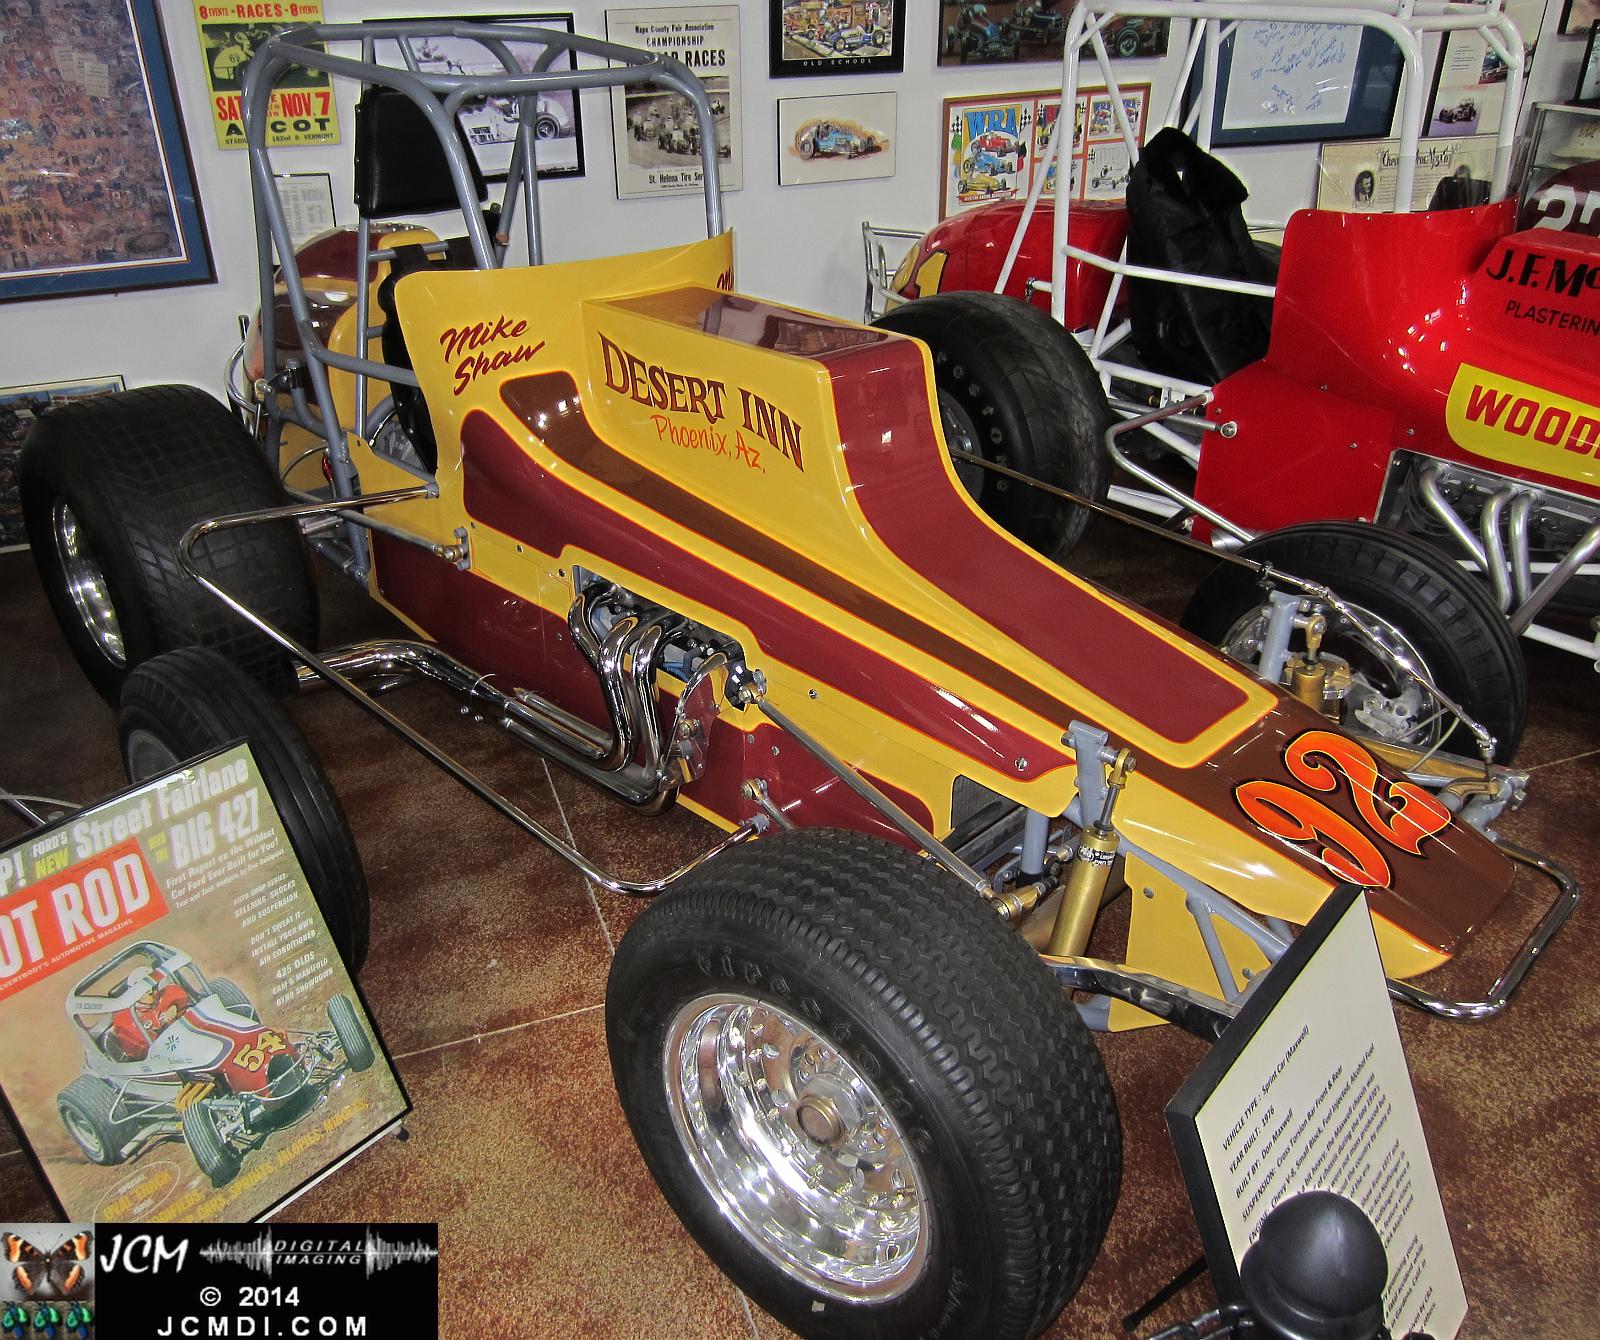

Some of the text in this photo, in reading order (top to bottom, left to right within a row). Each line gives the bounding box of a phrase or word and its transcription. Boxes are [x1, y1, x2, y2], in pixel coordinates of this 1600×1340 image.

[199, 3, 319, 19] 8 EVENTS RACES 8 EVENTS
[651, 25, 669, 33] County
[672, 24, 682, 32] Fair
[685, 23, 714, 31] Association
[646, 35, 704, 47] CHAMPIONSHIP
[685, 49, 726, 67] RACES
[831, 58, 871, 66] SCHOOL
[315, 92, 331, 116] 7
[965, 108, 1018, 138] WRA
[226, 118, 330, 136] ACOT
[660, 173, 678, 183] Helena
[681, 173, 691, 182] Tire
[439, 314, 531, 364] Mike
[453, 340, 546, 396] Shaw
[598, 331, 805, 473] DESERT INN
[1465, 384, 1600, 460] WOOD
[650, 414, 766, 474] Phoenix, Az.
[70, 757, 250, 860] Street Fairlane
[170, 811, 216, 870] BIG
[218, 786, 260, 845] 427
[1234, 729, 1452, 889] 92
[34, 847, 70, 880] NEW
[167, 827, 274, 888] First Report on the Wildest
[171, 837, 278, 899] Car Ford Ever Built for You!
[51, 852, 151, 947] ROD
[241, 891, 298, 927] AND SUSPENSION
[270, 879, 295, 898] SHOCKS
[51, 936, 97, 964] AUTOMOTIVE
[98, 918, 134, 940] MAGAZINE
[251, 915, 293, 944] DON'T SWEAT
[252, 916, 314, 957] INSTALL YOUR OWN
[259, 954, 270, 966] AIR
[272, 957, 328, 995] CAM MANIFOLD
[277, 950, 315, 979] 425 OLDS
[276, 967, 334, 1005] DYNO SHOWDOWN
[232, 1030, 287, 1073] 54
[1223, 1025, 1309, 1151] VEHICLE TYPE Sprint Car (Maxwell)
[1229, 1105, 1274, 1174] YEAR BUILT: 1976
[1242, 1168, 1276, 1222] SUSPENSION:
[1277, 1146, 1290, 1167] Cross
[1290, 1119, 1308, 1147] Torsion
[1307, 1107, 1315, 1121] Bar
[1316, 1087, 1328, 1108] Front
[1332, 1065, 1342, 1083] Rear
[1271, 1182, 1286, 1211] Chevy
[1296, 1145, 1309, 1169] Small
[1309, 1127, 1323, 1149] Block,
[1322, 1109, 1333, 1127] Fuel
[1332, 1082, 1351, 1112] Injected,
[1351, 1056, 1365, 1084] Alcohol
[1365, 1043, 1374, 1060] Fuel
[1312, 1151, 1327, 1175] heavy,
[1334, 1106, 1352, 1139] Maxwell
[1353, 1086, 1366, 1110] chassis
[1367, 1073, 1375, 1087] was
[1331, 1168, 1341, 1187] were
[1342, 1154, 1350, 1169] not
[1350, 1137, 1360, 1156] mass
[1360, 1104, 1379, 1140] produced
[1355, 1141, 1370, 1168] country
[1370, 1132, 1376, 1142] by
[1376, 1112, 1388, 1133] many
[1236, 1108, 1293, 1200] BUILT BY: Don Maxwell
[1318, 1105, 1367, 1188] of chassis during the late
[1351, 1186, 1355, 1198] of
[1372, 1171, 1382, 1189] from
